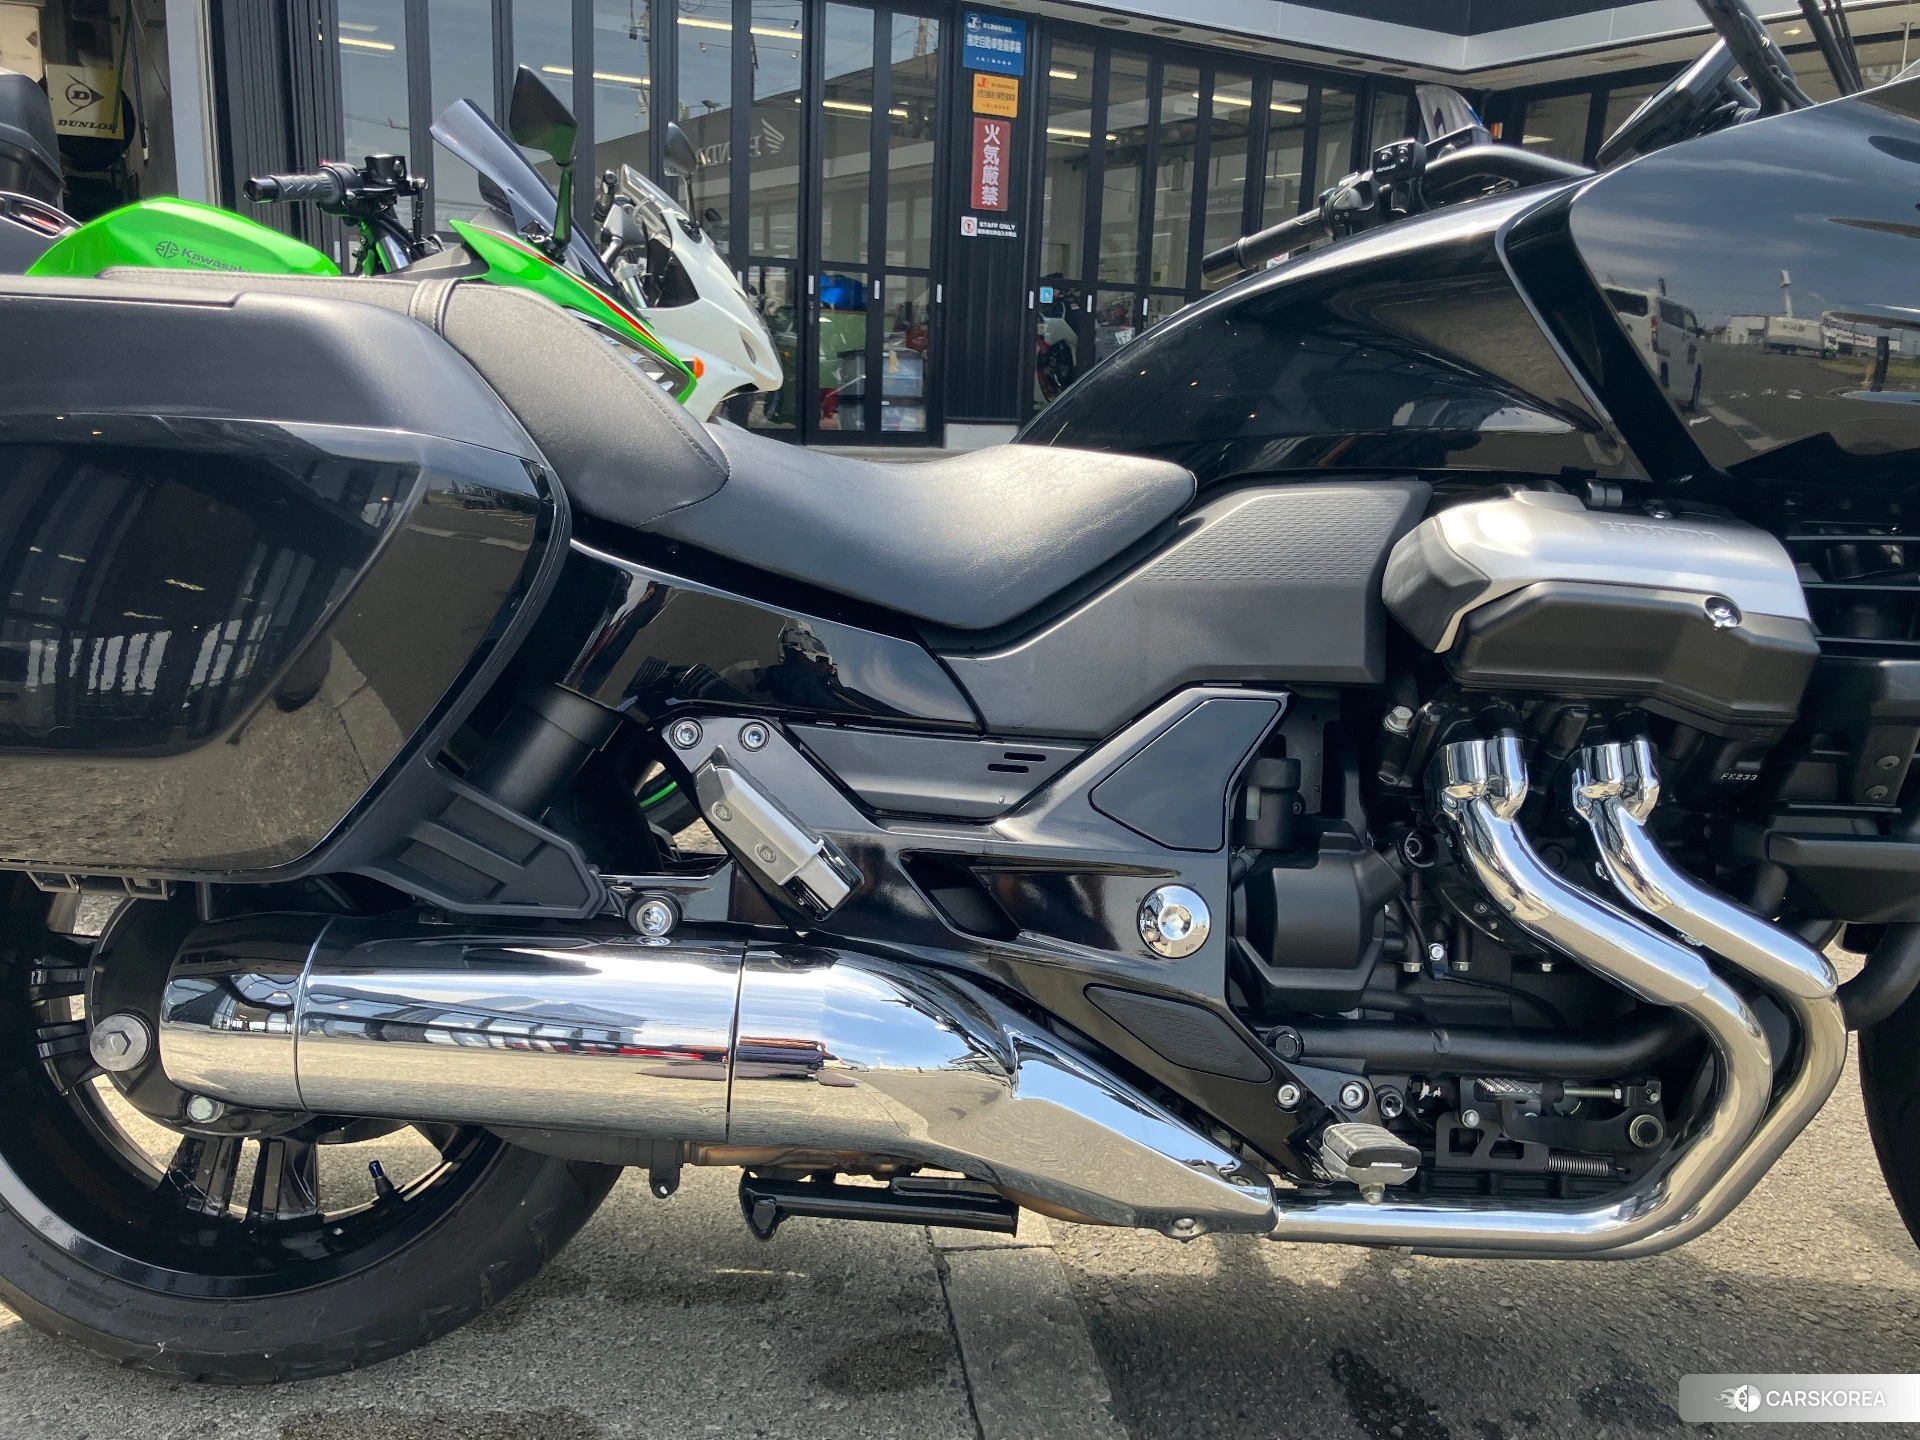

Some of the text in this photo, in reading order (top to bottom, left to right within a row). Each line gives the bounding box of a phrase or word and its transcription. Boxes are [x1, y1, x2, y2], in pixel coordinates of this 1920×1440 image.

[982, 123, 1000, 206] 火気厳禁
[181, 247, 252, 273] Kawasak
